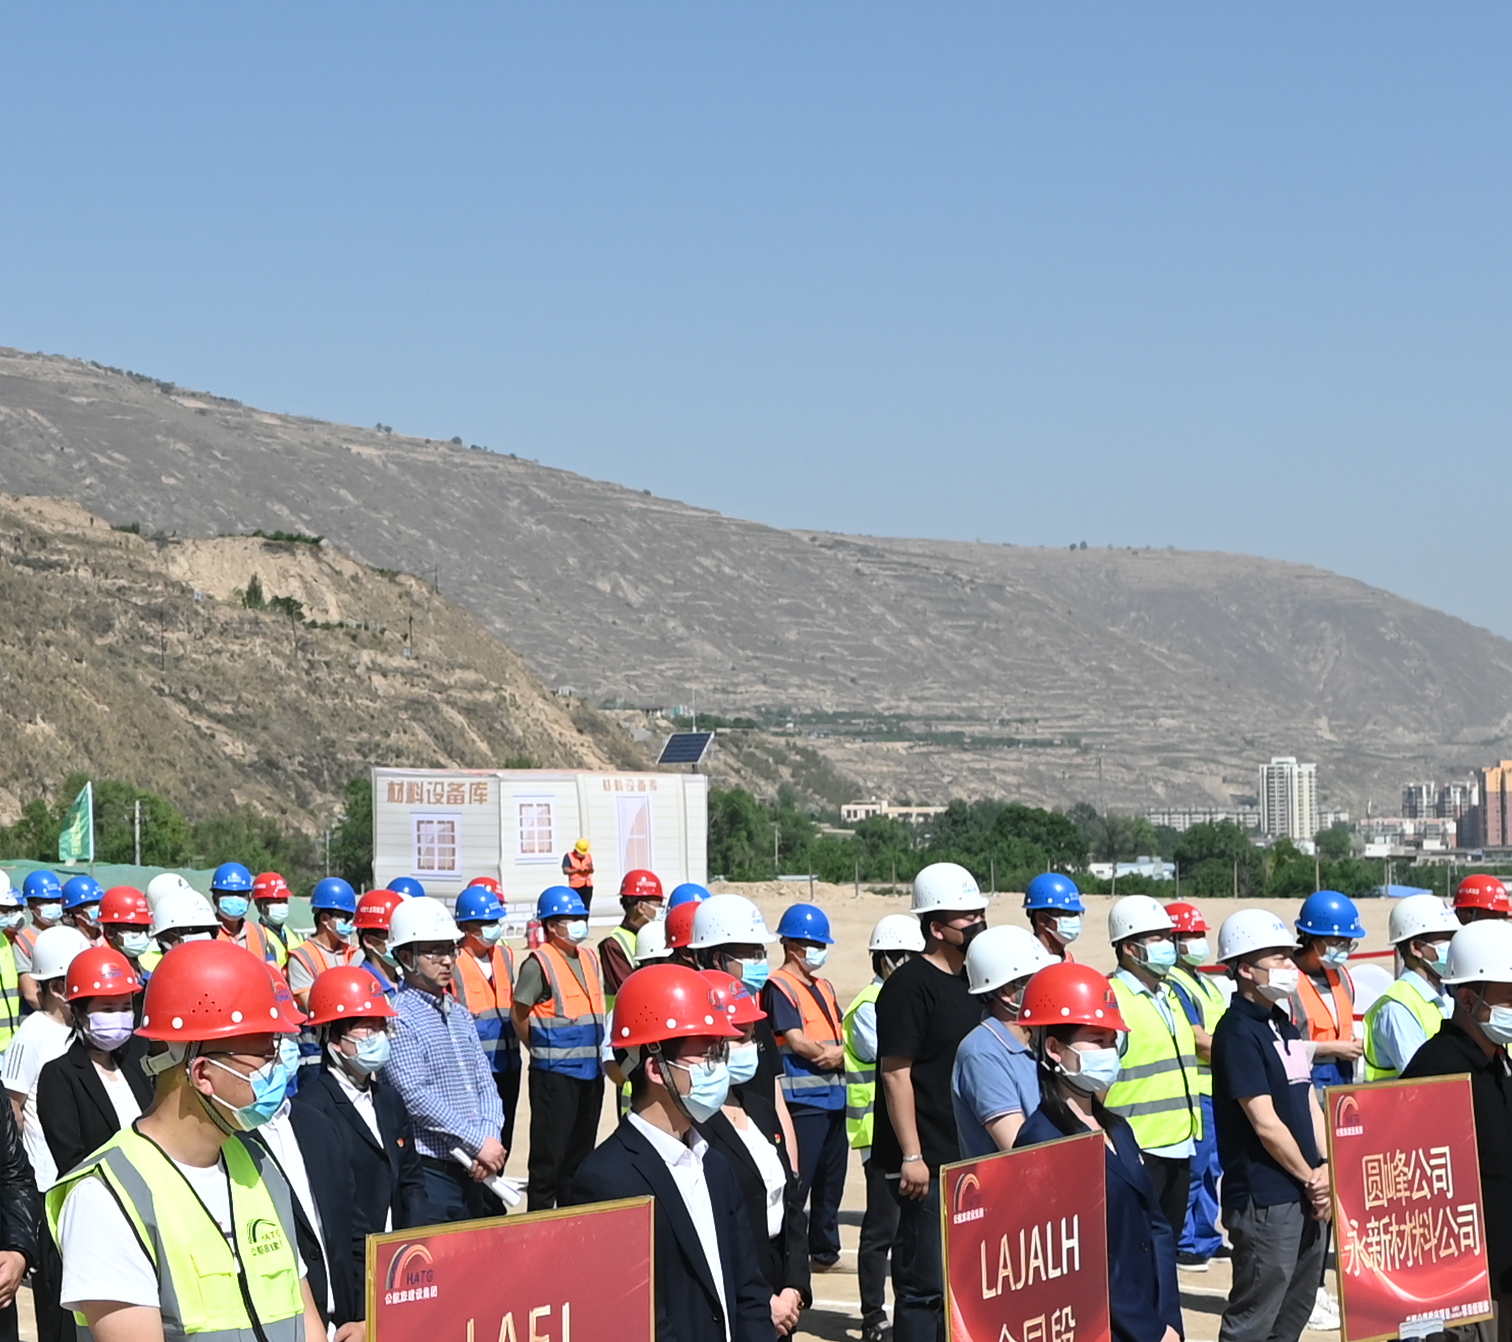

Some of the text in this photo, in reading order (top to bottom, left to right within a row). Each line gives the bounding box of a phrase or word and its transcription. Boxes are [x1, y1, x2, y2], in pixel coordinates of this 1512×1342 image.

[386, 780, 489, 806] 材料设备库
[602, 778, 659, 793] 材料设备库
[1361, 1145, 1454, 1211] 圆峰公司
[1344, 1202, 1481, 1278] 永新材料公司
[980, 1213, 1081, 1300] LAJALH
[406, 1268, 434, 1286] HATG
[384, 1285, 438, 1305] 公航旅建设集团
